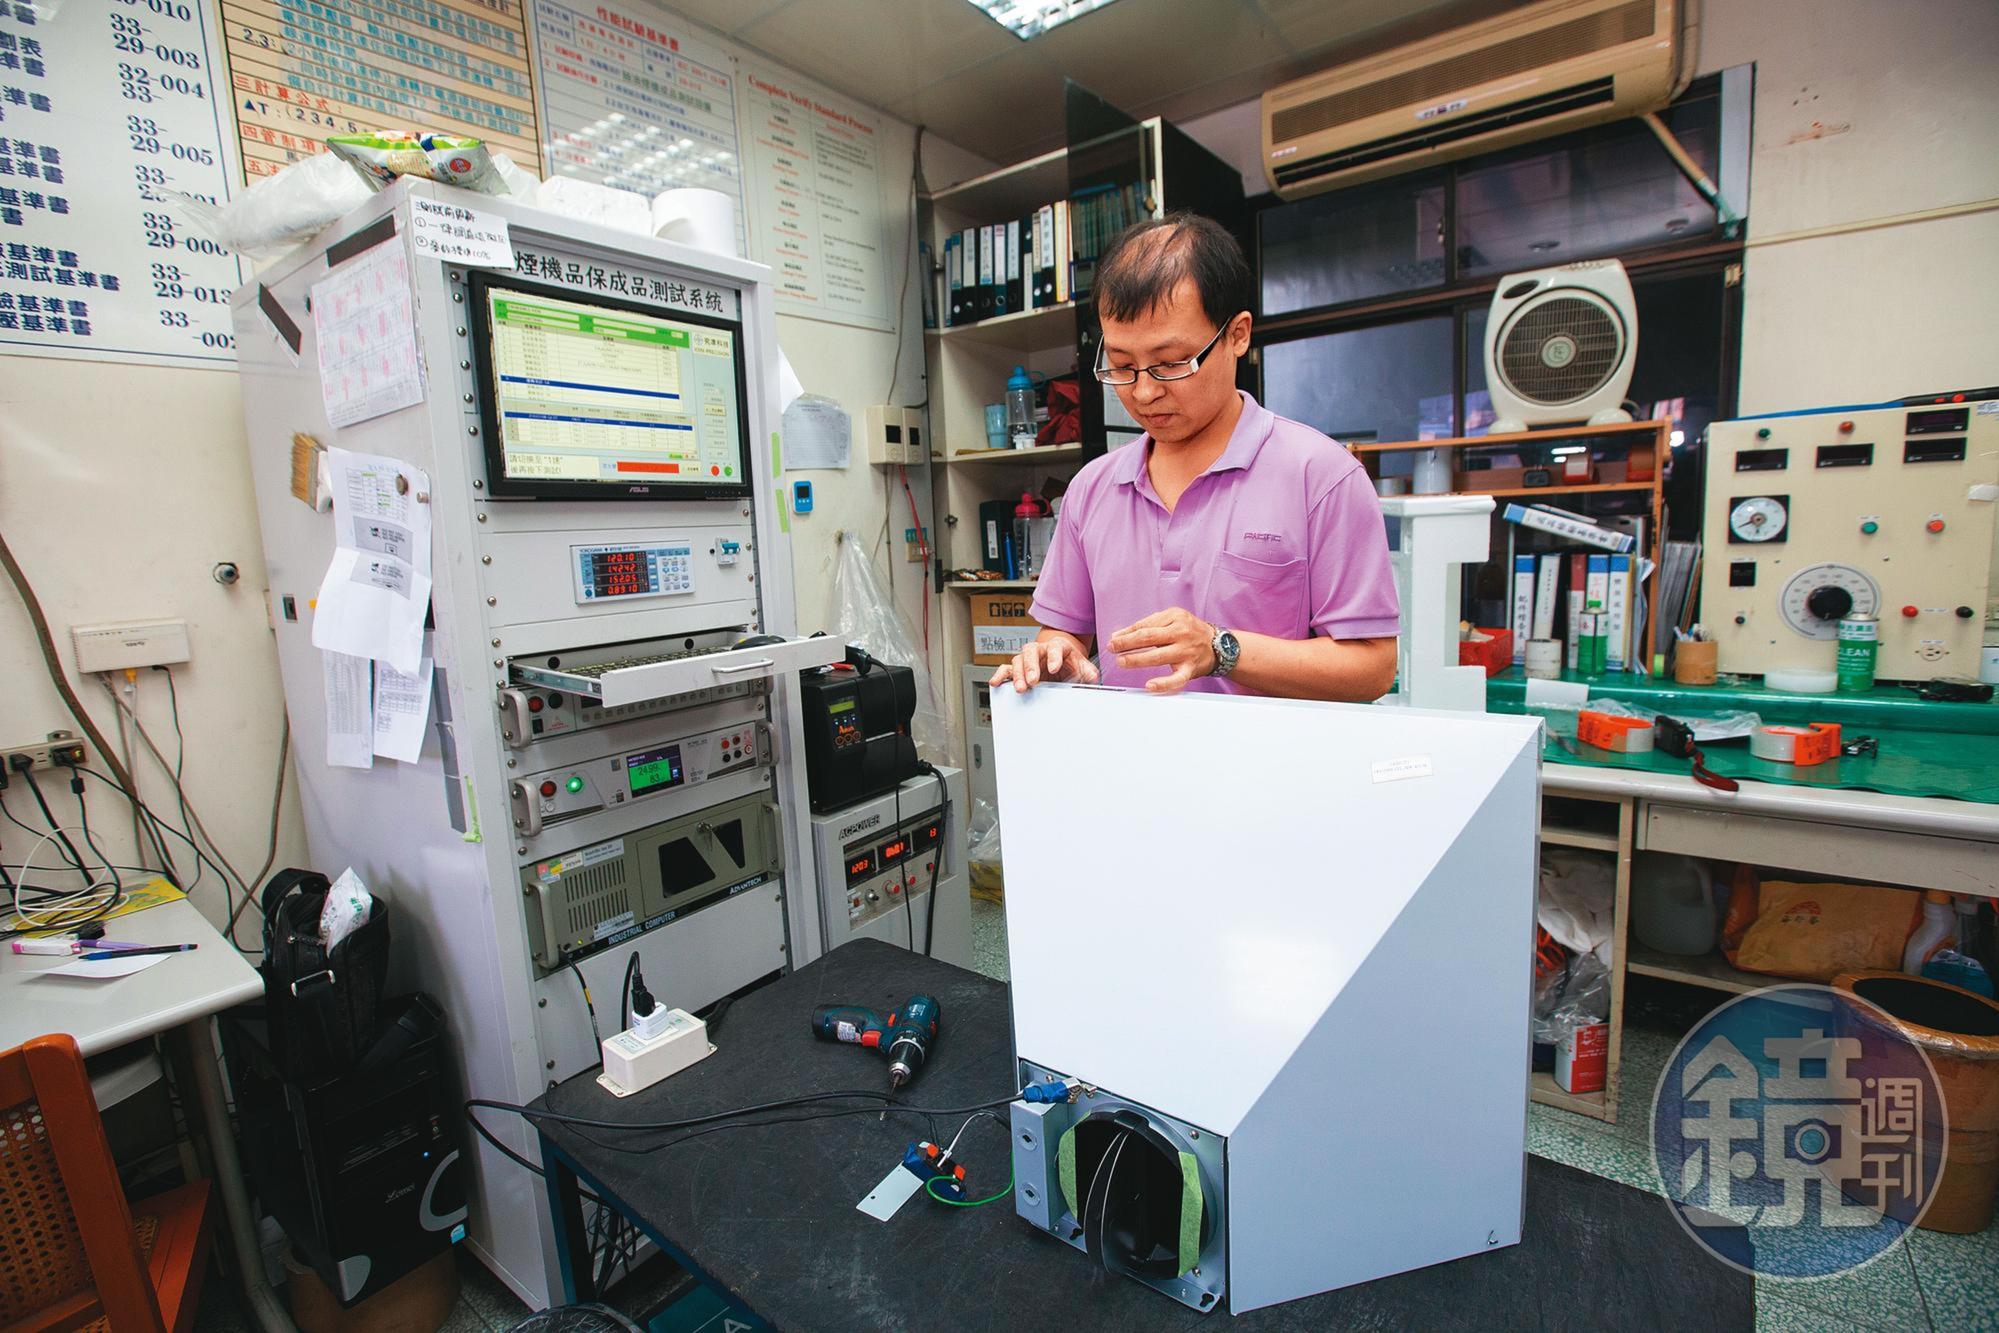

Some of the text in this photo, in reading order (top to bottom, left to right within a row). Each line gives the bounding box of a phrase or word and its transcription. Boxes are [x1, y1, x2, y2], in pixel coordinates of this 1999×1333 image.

[113, 33, 200, 69] 29-003
[118, 62, 206, 99] 32-004
[130, 134, 213, 166] 29-005
[0, 261, 120, 291] 測試基準書
[493, 250, 724, 313] 煙機品保成品測試系統
[1243, 532, 1282, 542] PACIFIC
[729, 876, 762, 895] ADVANTECH
[608, 924, 643, 945] INDUSTRIAL
[645, 911, 676, 930] COMPUTER
